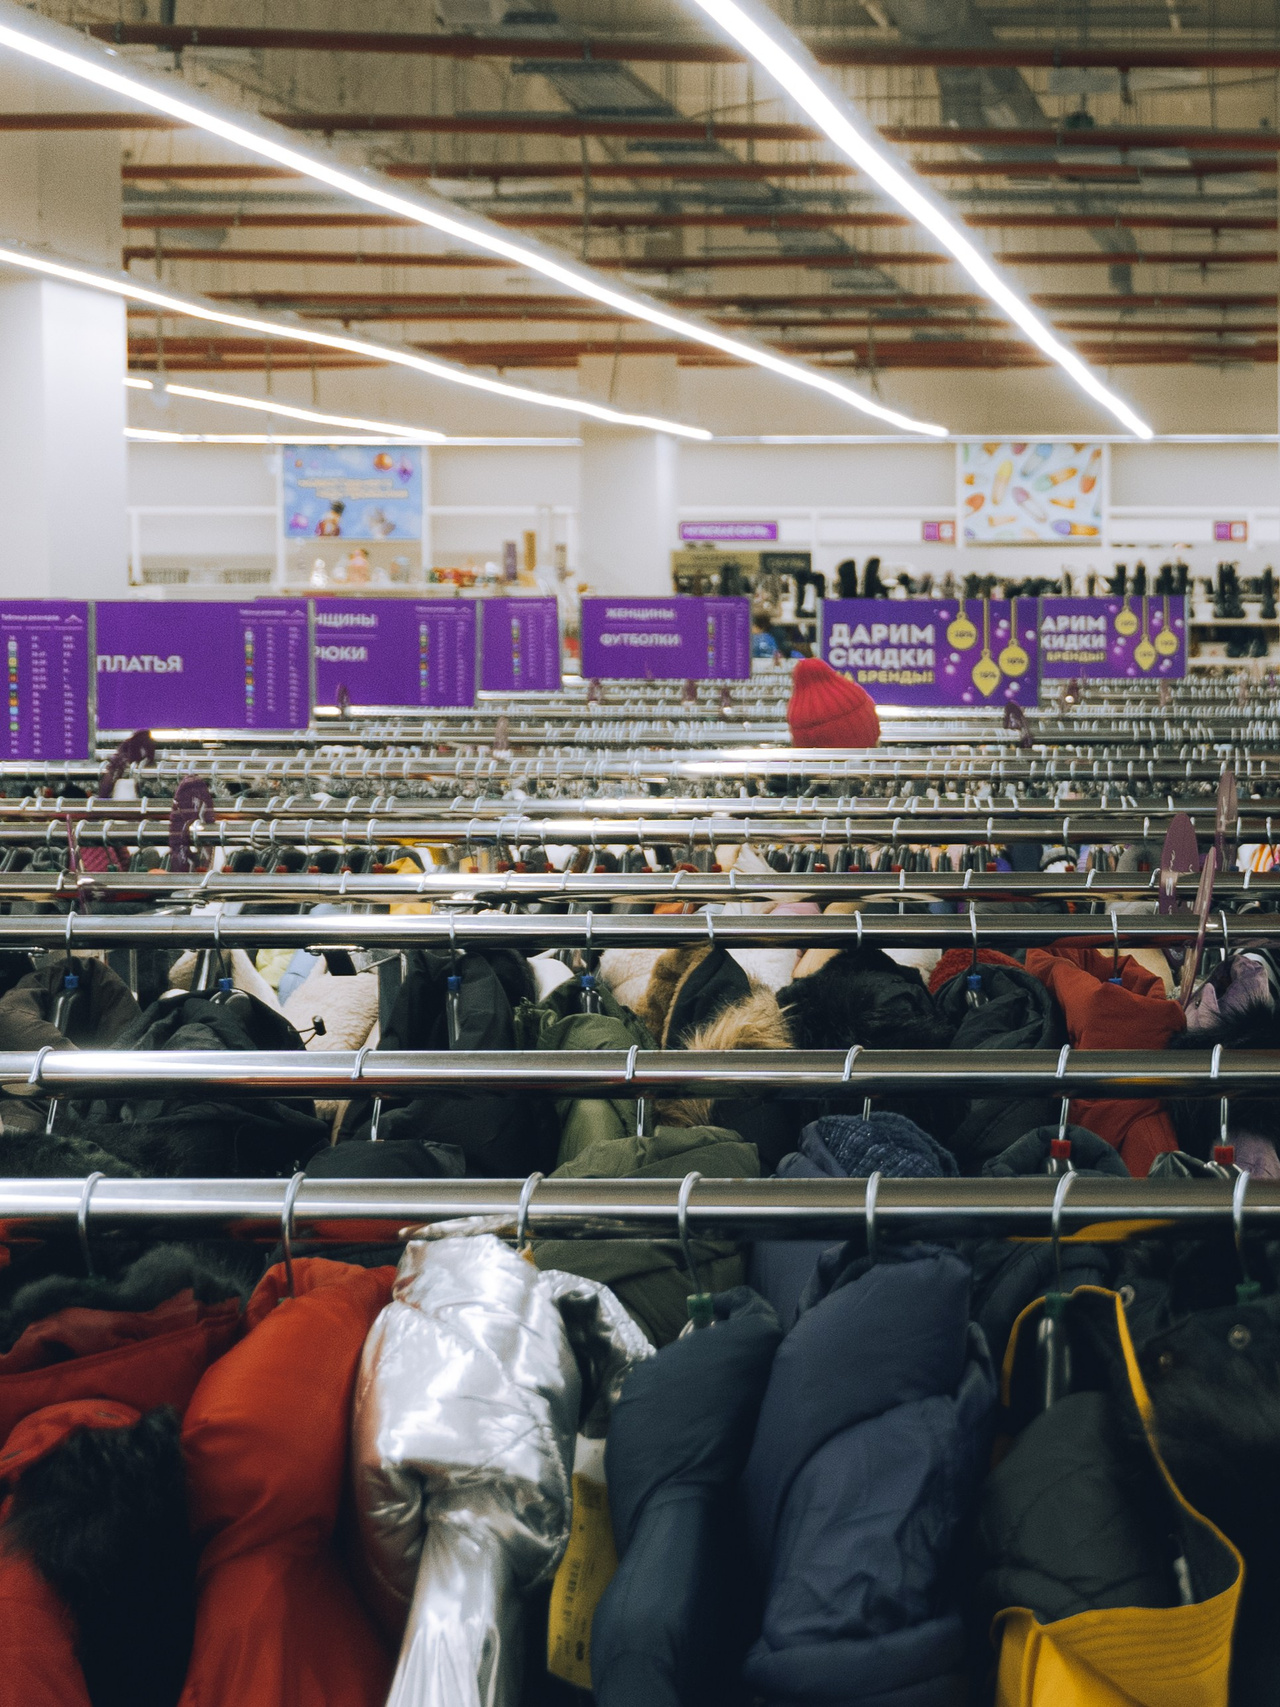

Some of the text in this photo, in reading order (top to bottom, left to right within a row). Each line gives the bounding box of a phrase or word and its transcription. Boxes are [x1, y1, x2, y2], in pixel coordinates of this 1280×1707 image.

[605, 608, 675, 620] ЖЕНЩИНЫ
[1041, 615, 1107, 632] АРИМ
[599, 633, 681, 647] ФУТБОЛКИ
[829, 624, 935, 646] ДАРИМ
[1041, 634, 1107, 650] КИДКИ
[96, 655, 182, 673] ПЛАТЬЯ
[829, 648, 935, 669] СКИДКИ
